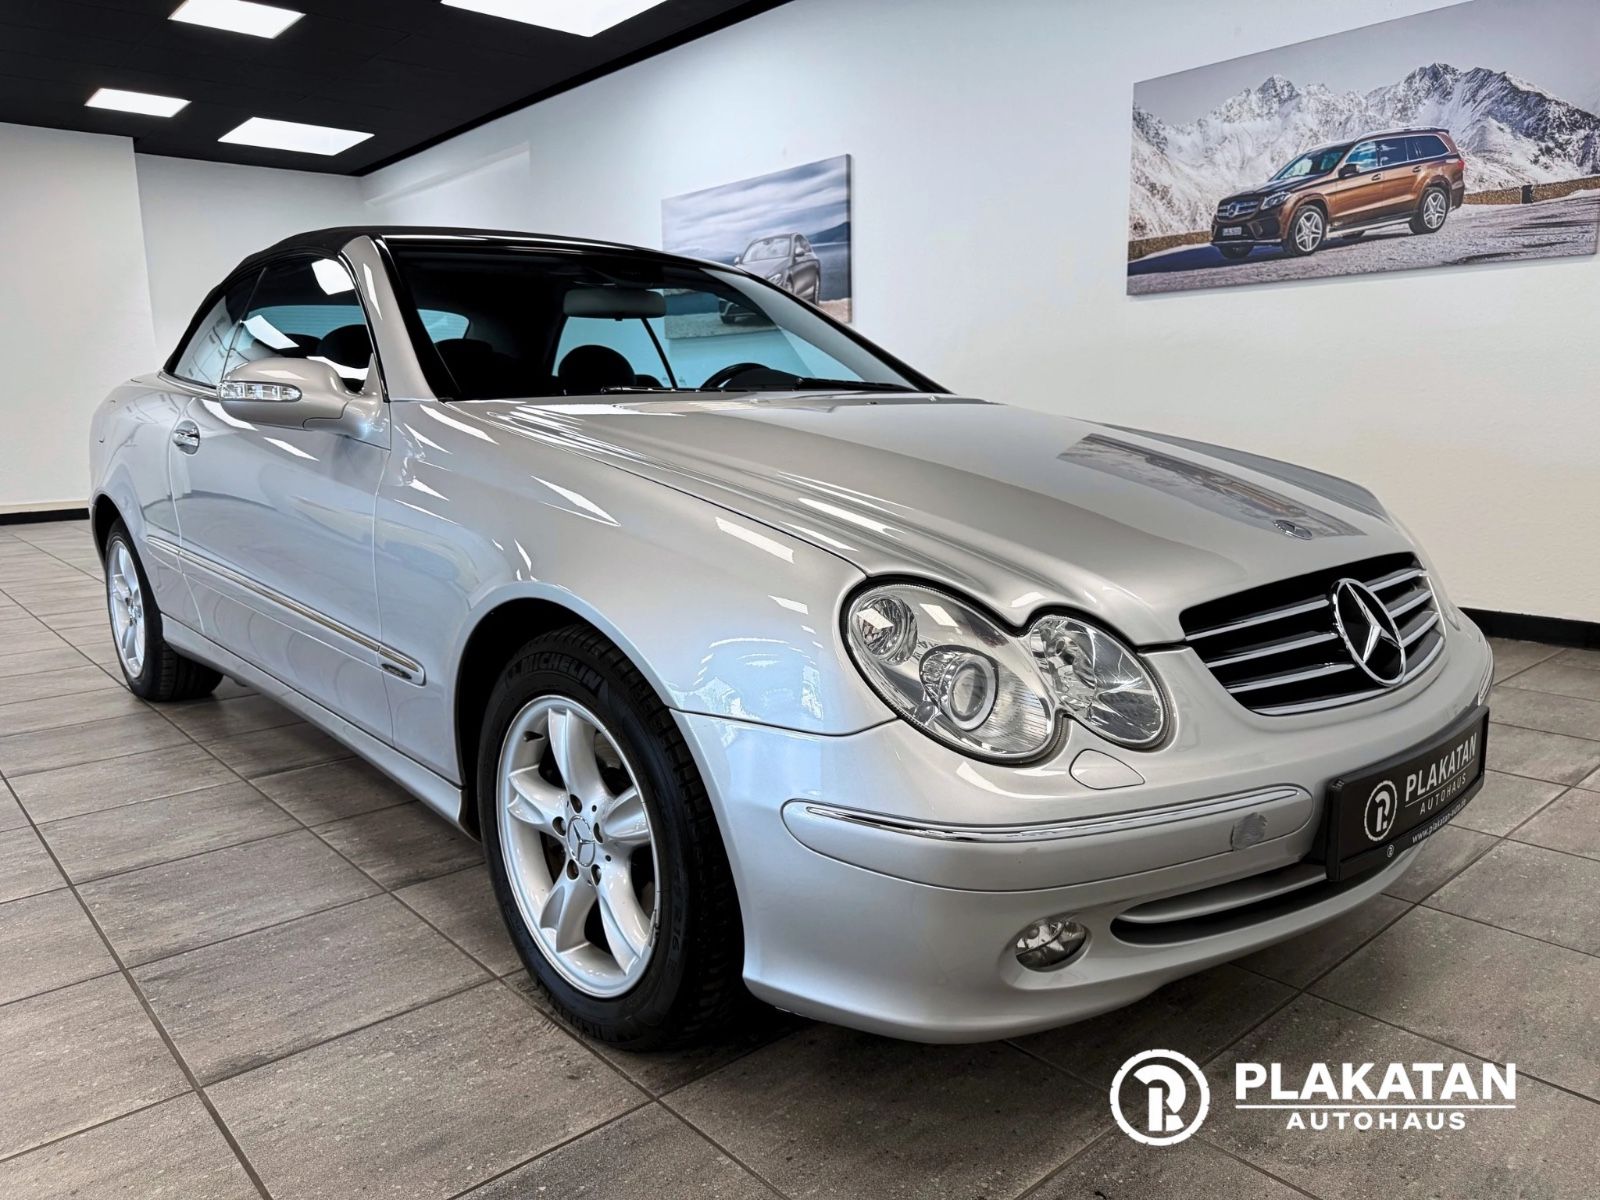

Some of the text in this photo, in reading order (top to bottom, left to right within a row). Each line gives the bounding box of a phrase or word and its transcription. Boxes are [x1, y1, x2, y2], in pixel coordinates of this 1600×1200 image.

[520, 652, 601, 691] MICHELIN
[1405, 732, 1477, 802] PLAKATAN
[1420, 773, 1466, 816] AUTOHAUS
